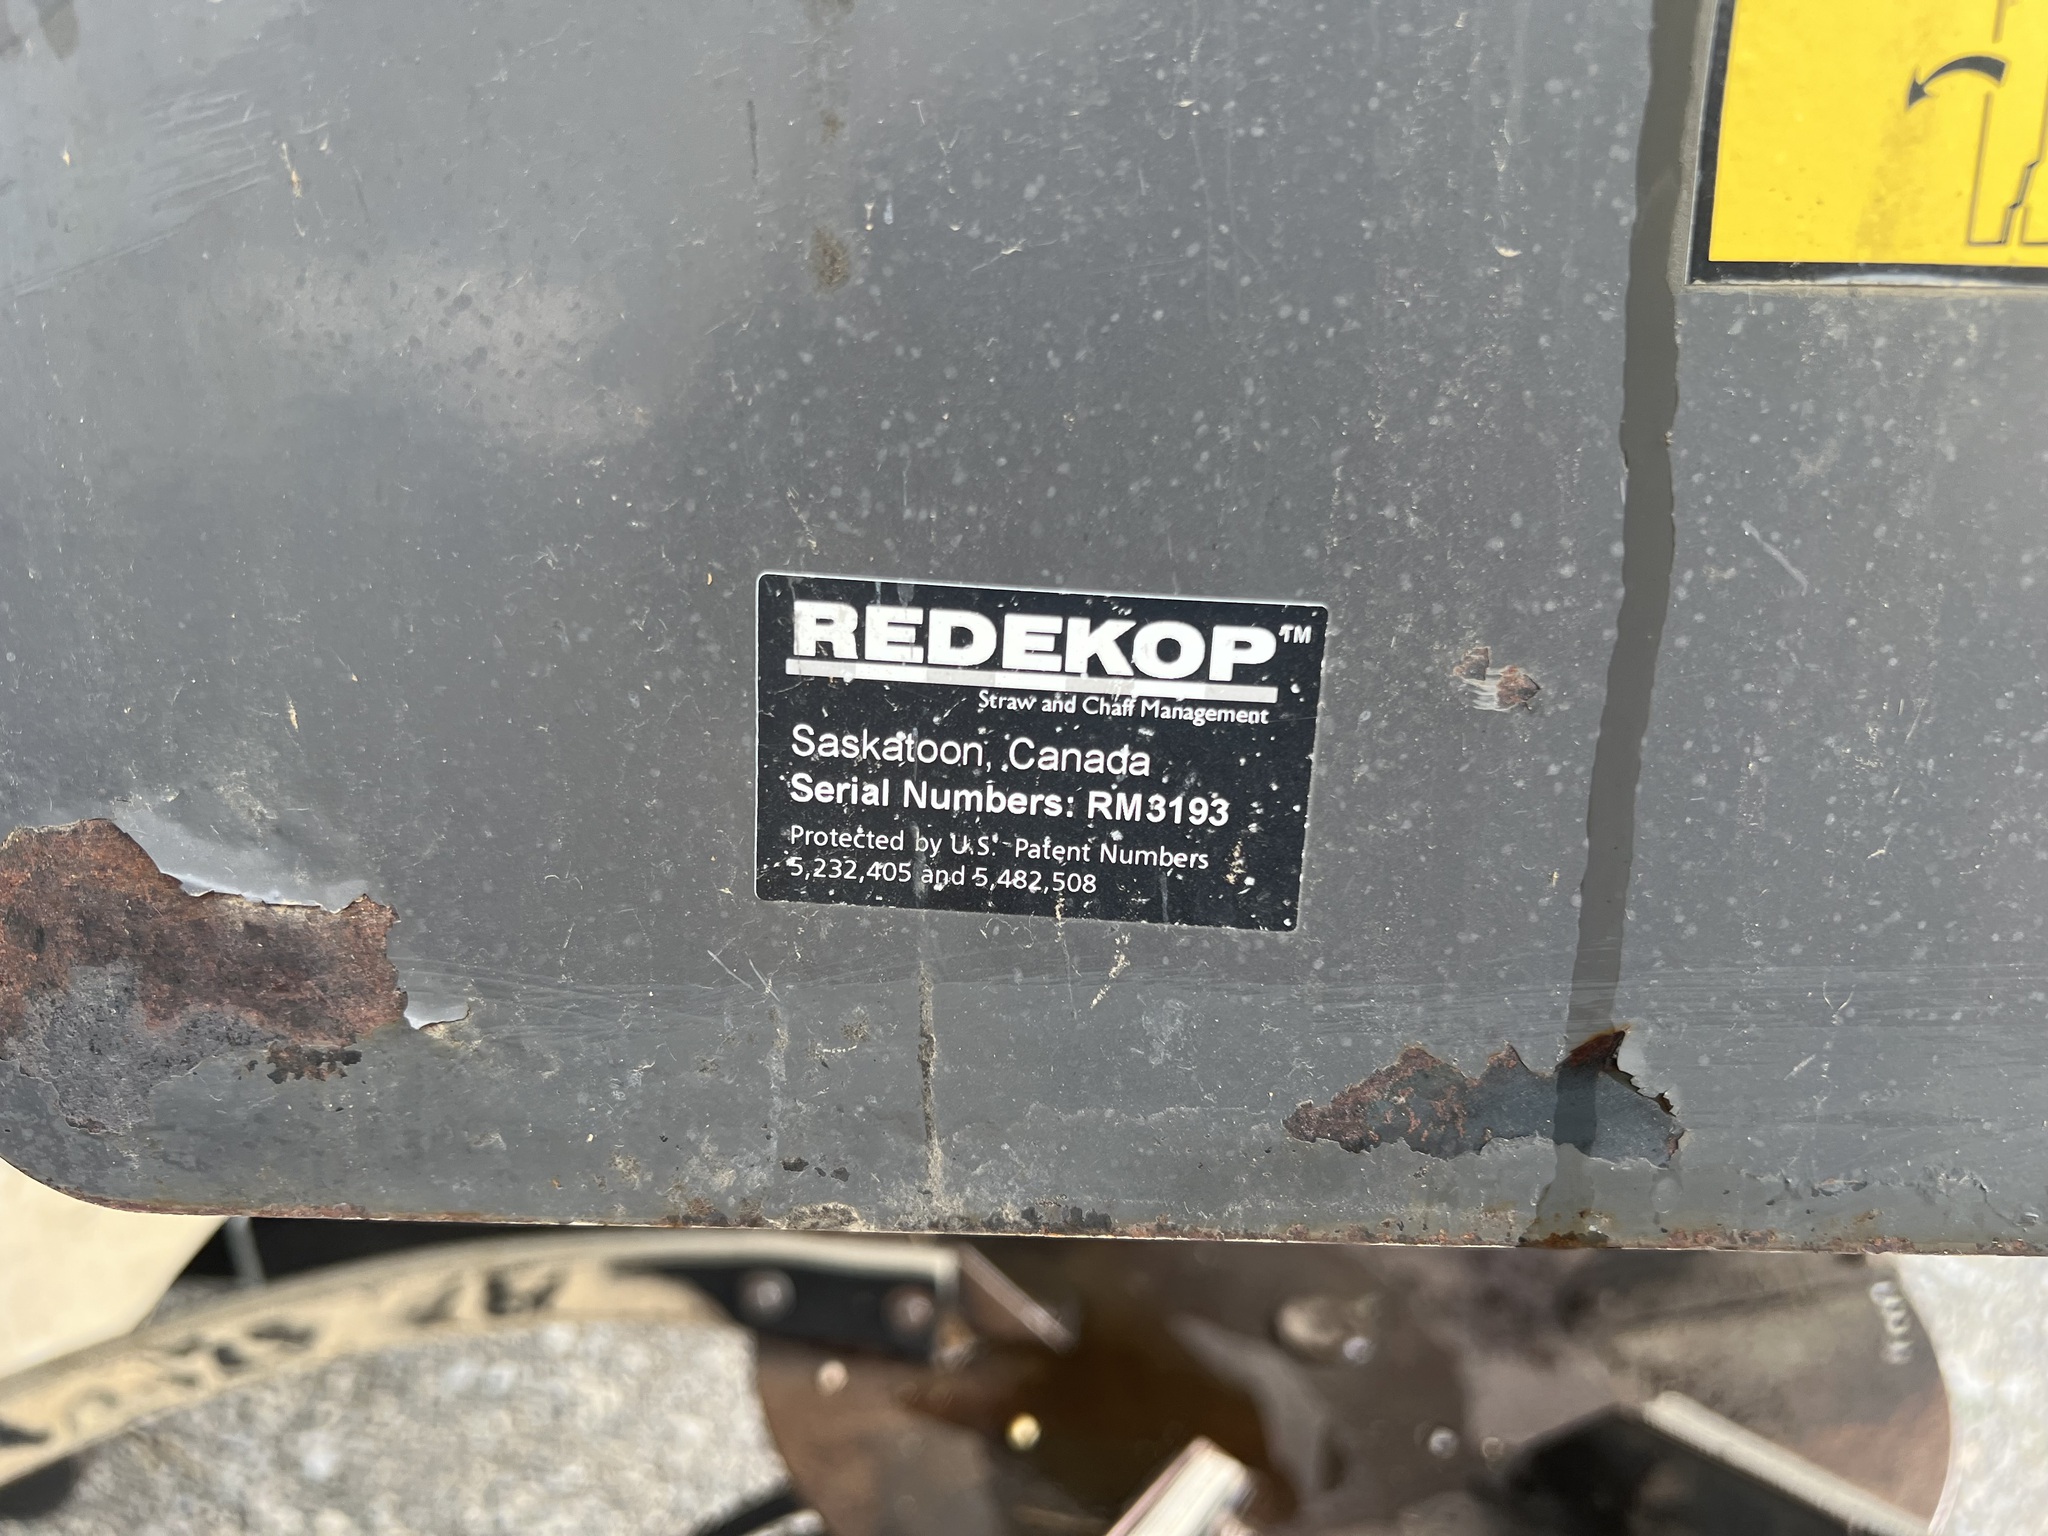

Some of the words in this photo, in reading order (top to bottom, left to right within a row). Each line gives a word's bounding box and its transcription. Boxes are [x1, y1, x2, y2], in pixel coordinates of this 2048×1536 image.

[794, 600, 1276, 681] REDEKOP
[978, 689, 1037, 712] Straw
[1042, 695, 1076, 714] and
[1082, 696, 1136, 717] Chaff
[1140, 699, 1270, 727] Management
[791, 723, 992, 773] Saskatoon,
[1008, 736, 1150, 777] Canada
[790, 772, 890, 807] Serial
[903, 779, 1074, 818] Numbers:
[1087, 790, 1230, 827] RM3193
[790, 824, 905, 851] Protected
[915, 832, 943, 858] by
[951, 834, 996, 857] U.S.
[1014, 837, 1091, 863] Patent
[1099, 843, 1210, 870] Numbers
[790, 856, 912, 884] 5,232,405
[920, 864, 966, 886] and
[974, 867, 1097, 895] 5,482,508
